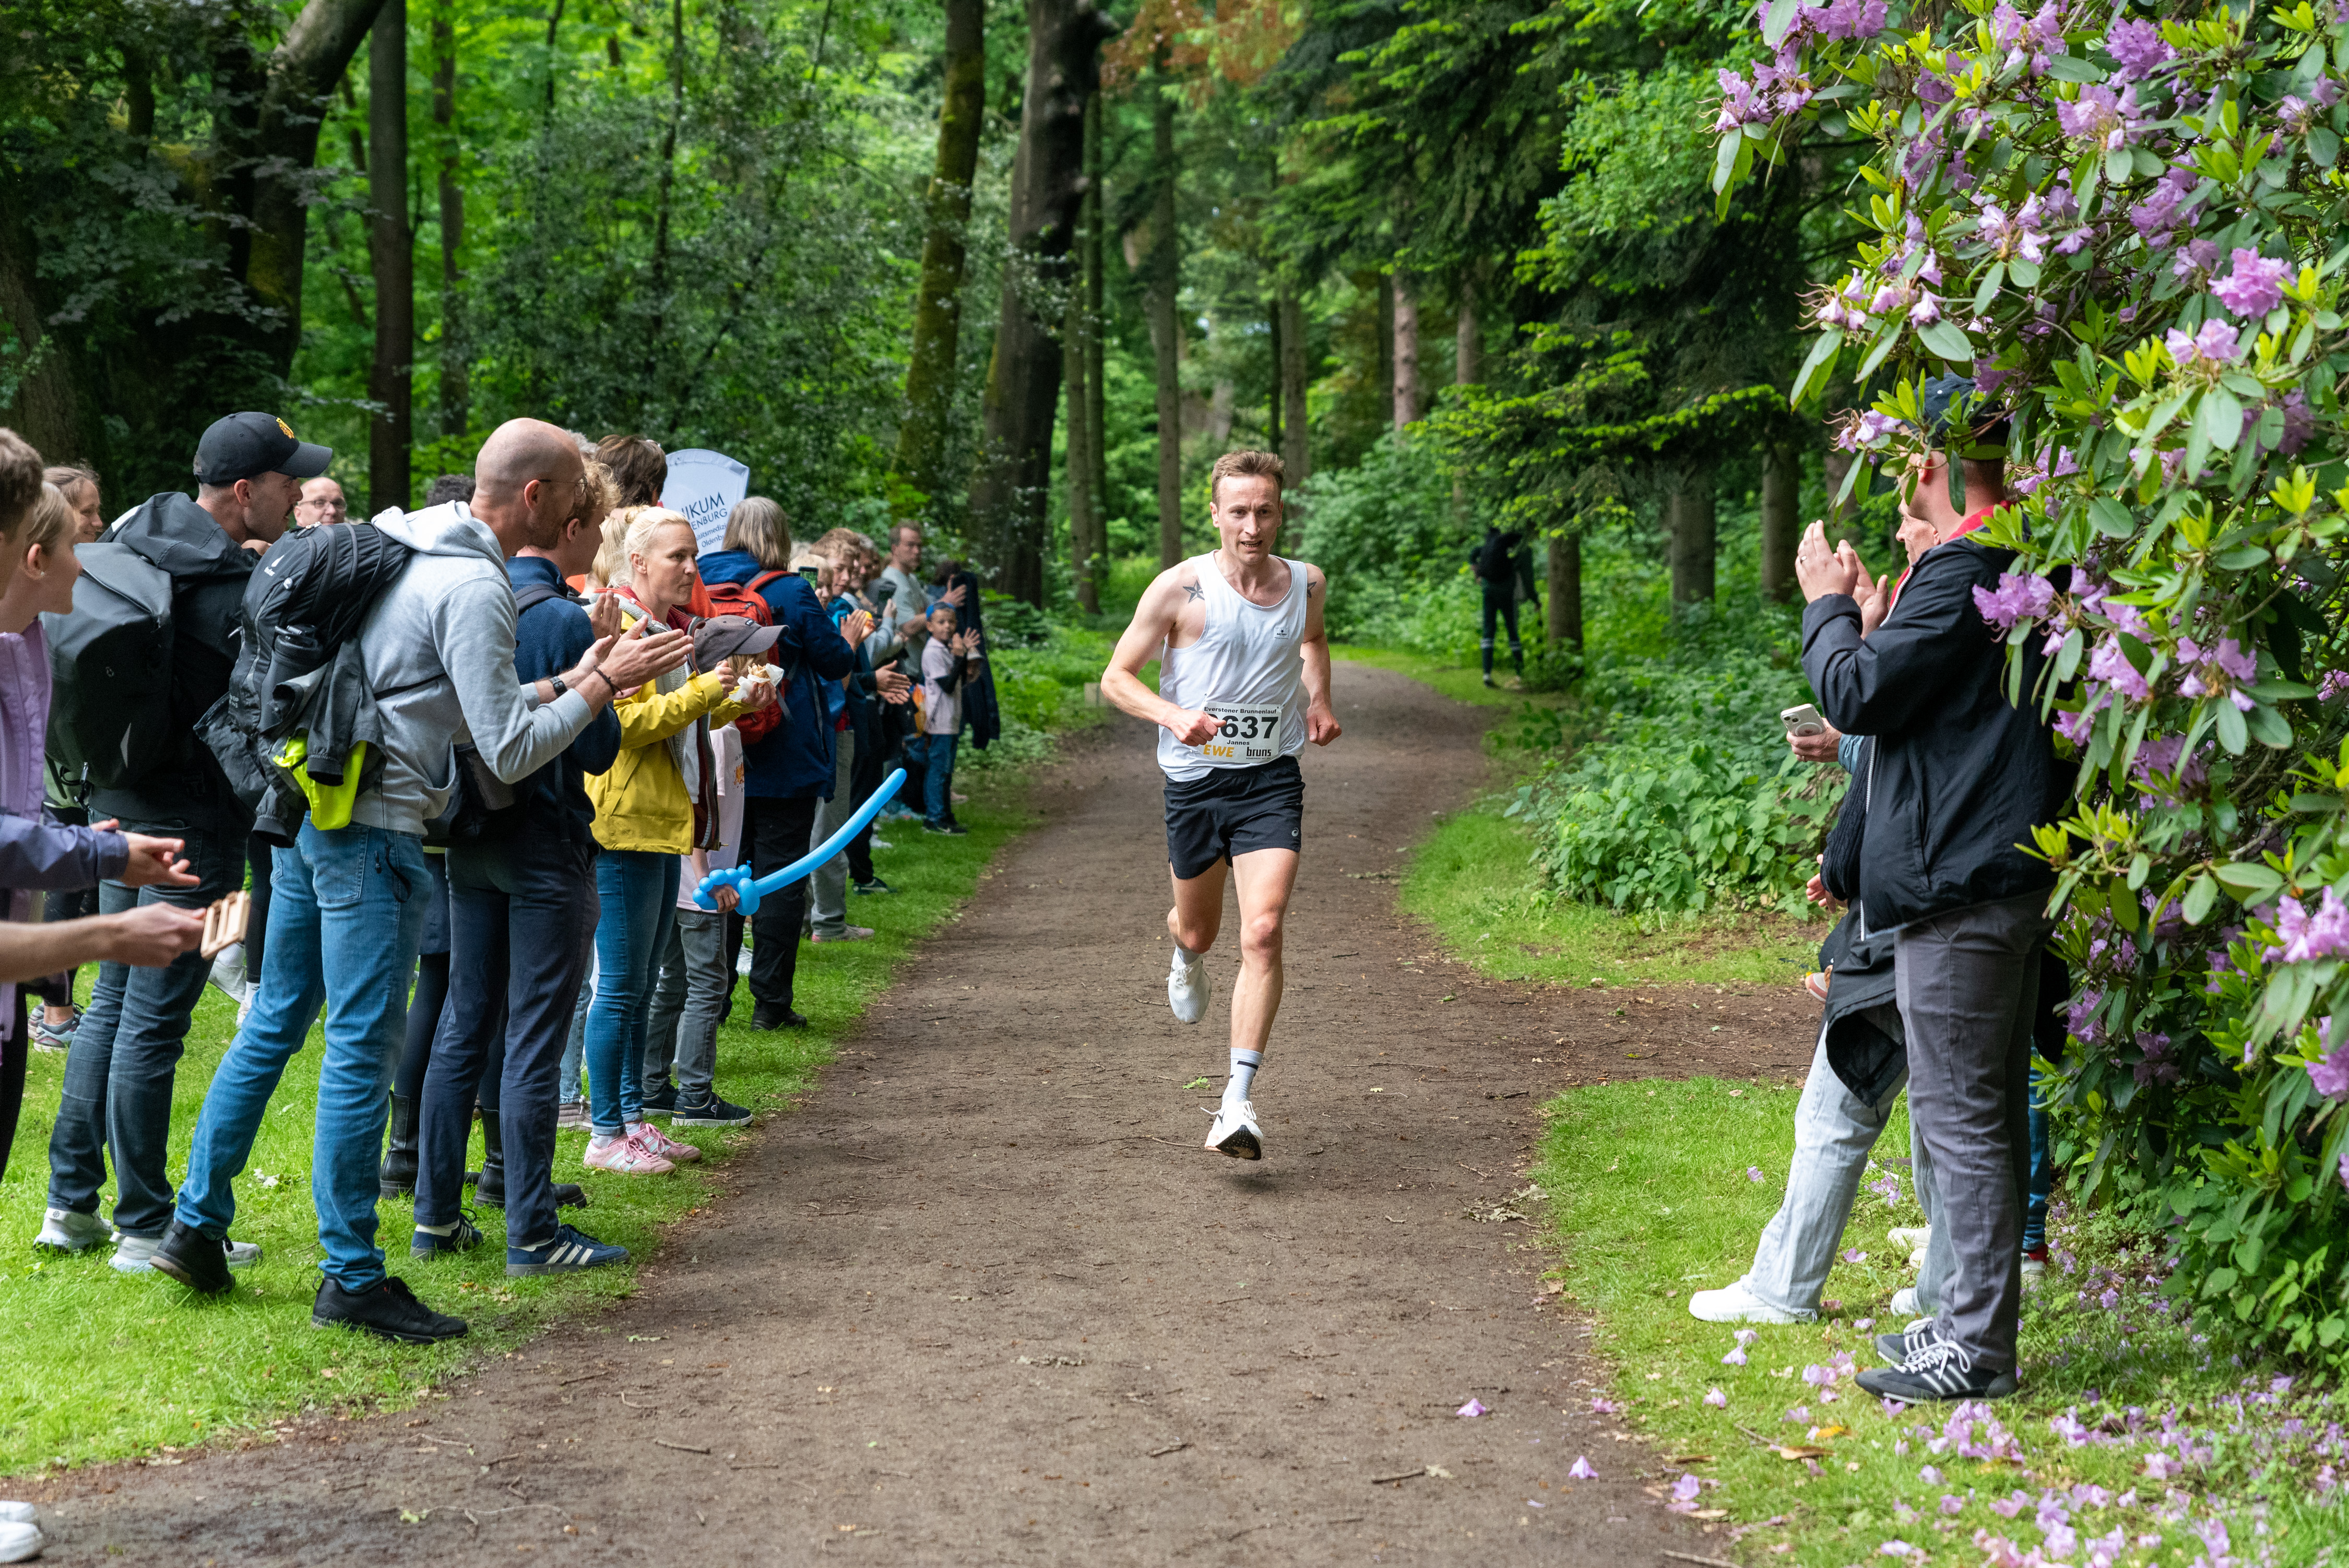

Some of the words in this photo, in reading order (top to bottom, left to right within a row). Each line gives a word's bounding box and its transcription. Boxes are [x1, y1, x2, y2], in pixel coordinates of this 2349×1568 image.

[691, 508, 728, 530] ENBURG
[1203, 744, 1235, 757] EWE
[1246, 746, 1272, 757] bruns
